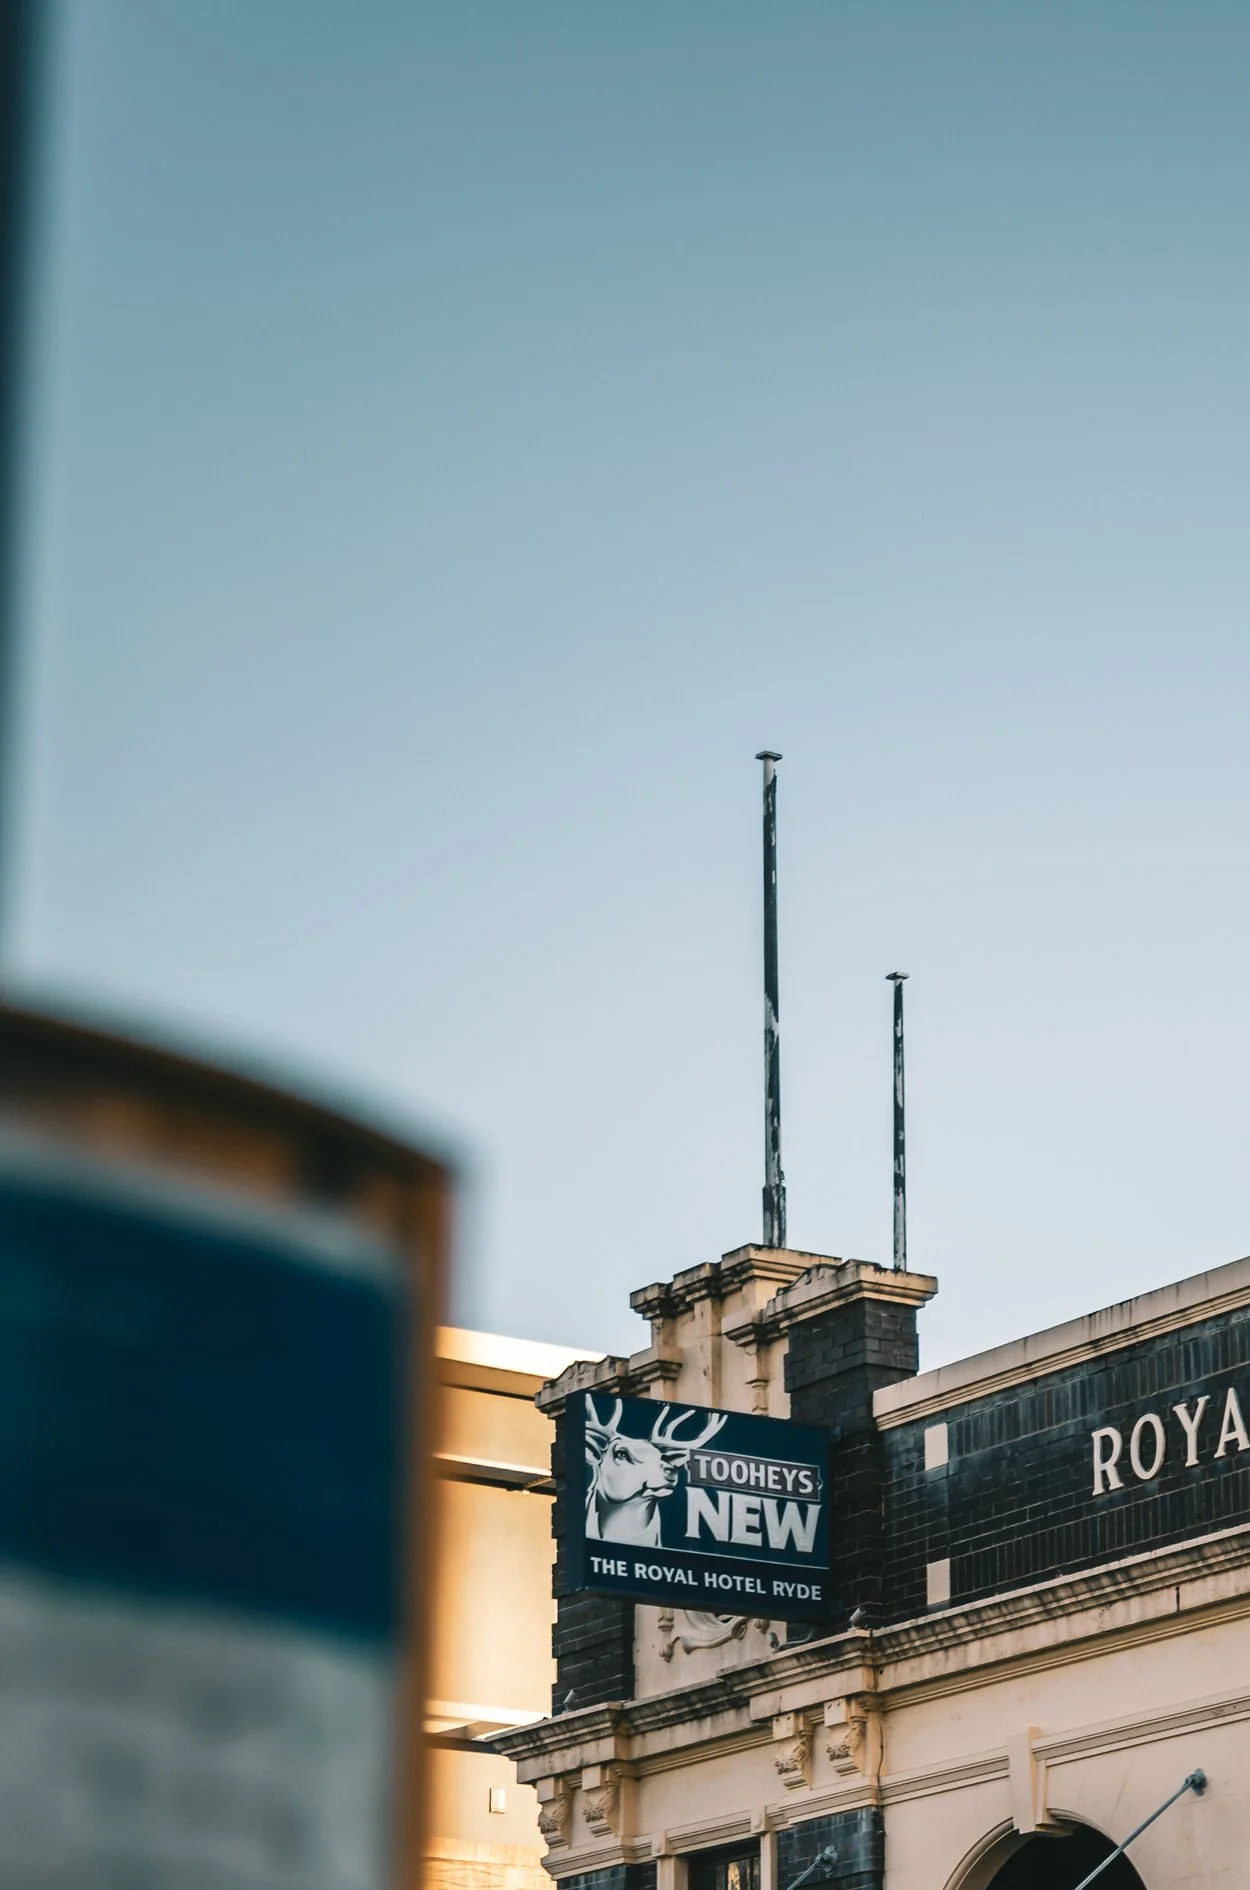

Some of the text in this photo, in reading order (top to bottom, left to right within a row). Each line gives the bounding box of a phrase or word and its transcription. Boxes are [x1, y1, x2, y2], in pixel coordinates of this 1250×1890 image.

[694, 1454, 814, 1494] TOOHEYS
[684, 1486, 823, 1553] NEW
[590, 1557, 822, 1601] THE ROYAL HOTEL RYDE
